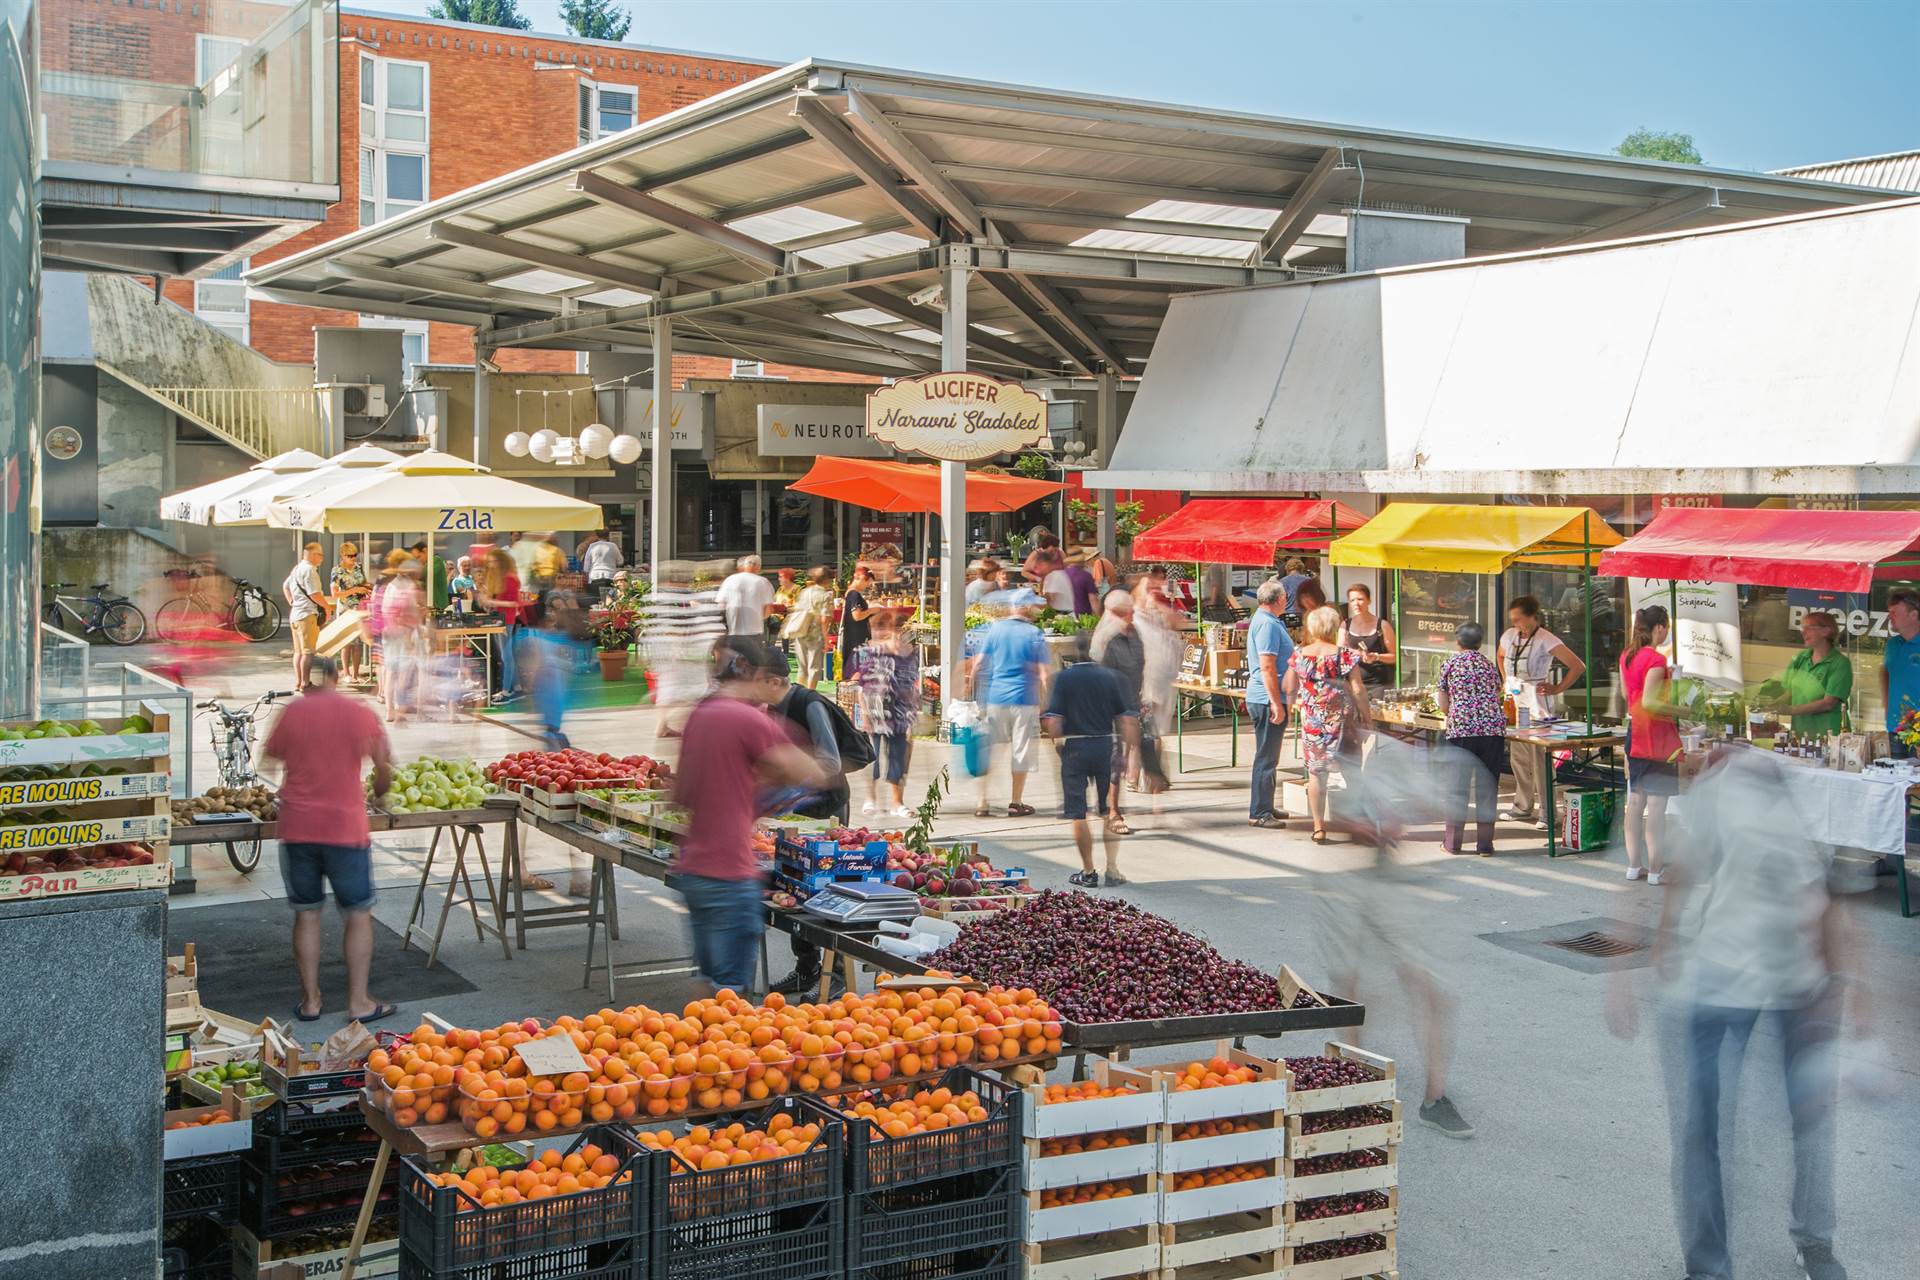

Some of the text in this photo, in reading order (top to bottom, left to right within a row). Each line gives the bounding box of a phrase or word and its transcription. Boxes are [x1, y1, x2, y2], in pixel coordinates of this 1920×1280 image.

[924, 380, 999, 404] LUCIFER
[795, 424, 876, 438] NEUROT
[877, 408, 1040, 434] Naravni Sladoled
[640, 431, 688, 440] NETH
[437, 508, 494, 529] Zala
[1418, 620, 1455, 632] Breeze
[1571, 809, 1579, 841] SPAR
[19, 875, 78, 895] Pan
